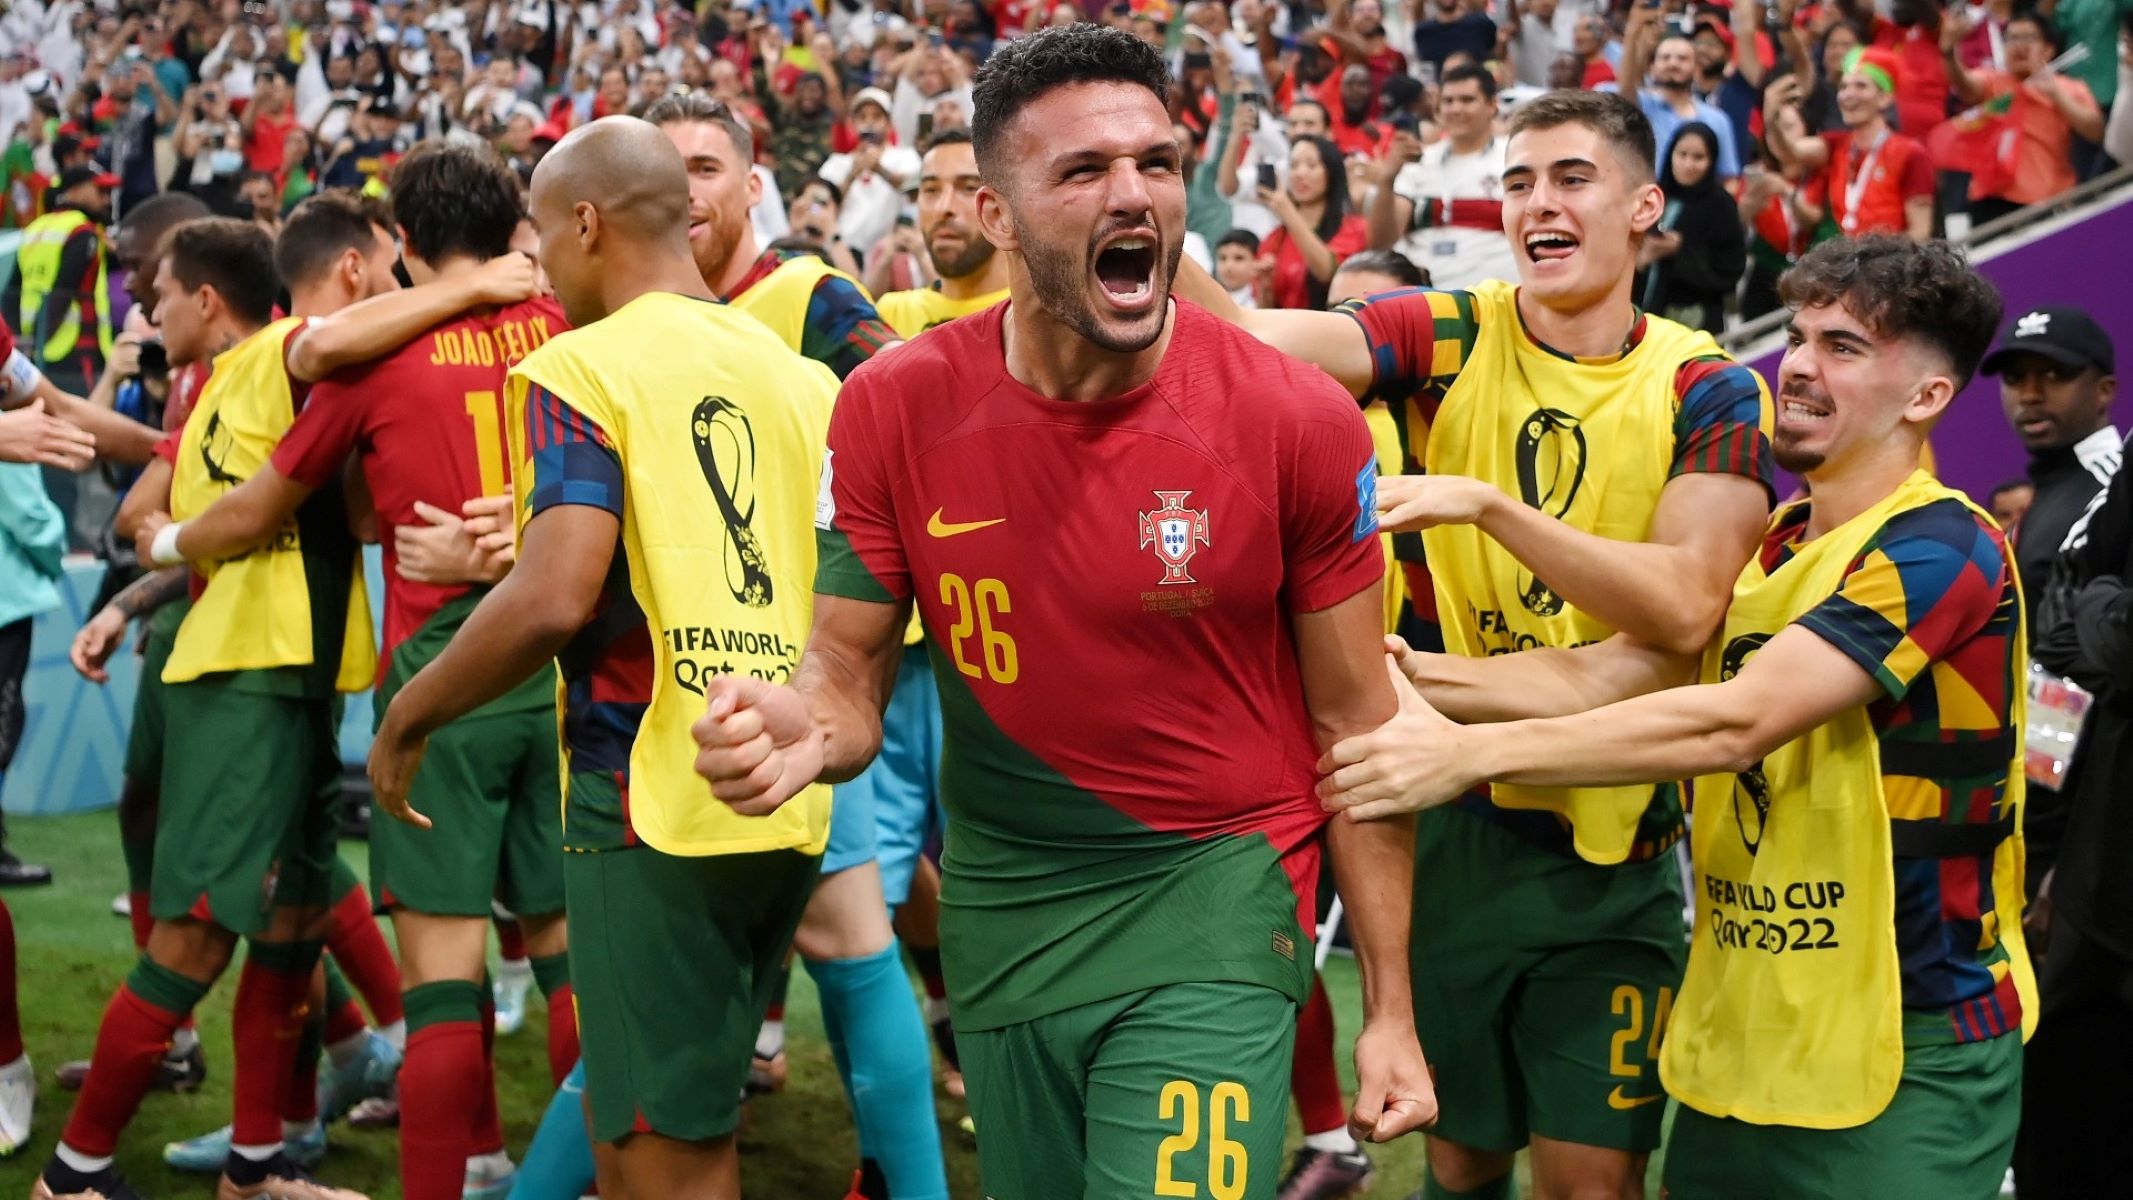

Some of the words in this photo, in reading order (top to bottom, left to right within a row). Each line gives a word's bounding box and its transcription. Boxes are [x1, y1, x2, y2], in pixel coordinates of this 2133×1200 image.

[940, 572, 1019, 684] 26
[1140, 590, 1183, 601] PORTUGAL
[1784, 881, 1845, 910] CUP
[1154, 1080, 1250, 1200] 26
